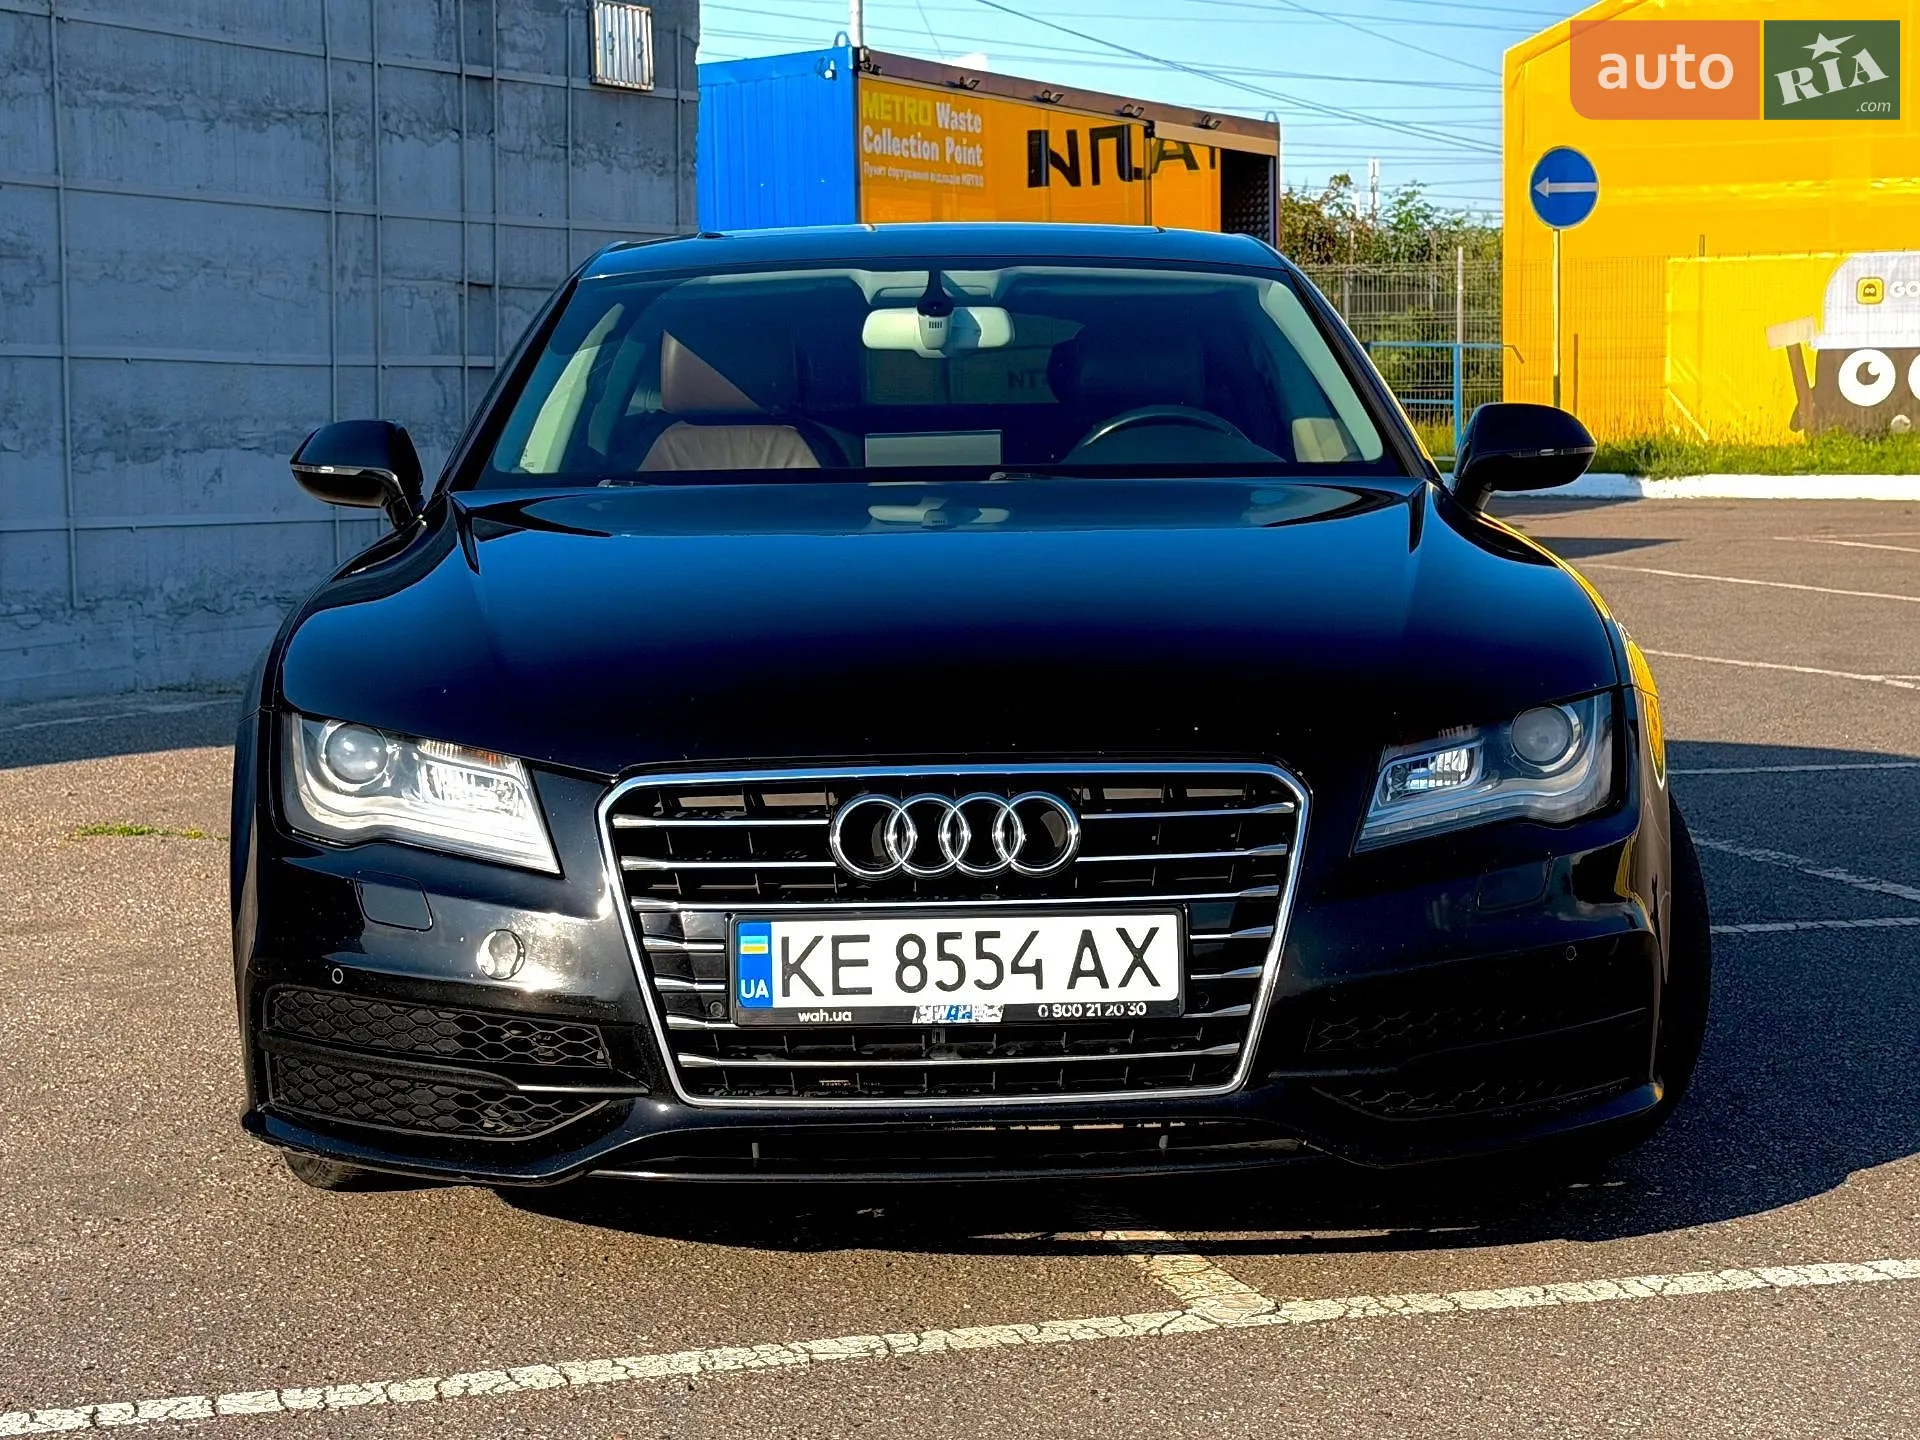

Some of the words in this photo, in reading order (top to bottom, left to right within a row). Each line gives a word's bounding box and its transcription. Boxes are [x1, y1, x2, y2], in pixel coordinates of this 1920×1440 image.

[862, 90, 931, 126] METRO
[936, 101, 982, 134] Waste
[863, 125, 939, 162] Collection
[945, 136, 983, 167] Point
[780, 934, 873, 998] KE
[894, 930, 1044, 993] 8554
[1067, 927, 1161, 990] AX
[741, 979, 769, 998] UA
[798, 1009, 852, 1023] wah.ua
[1037, 1004, 1049, 1018] 0
[1086, 1003, 1102, 1017] 21
[1104, 1003, 1124, 1017] 20
